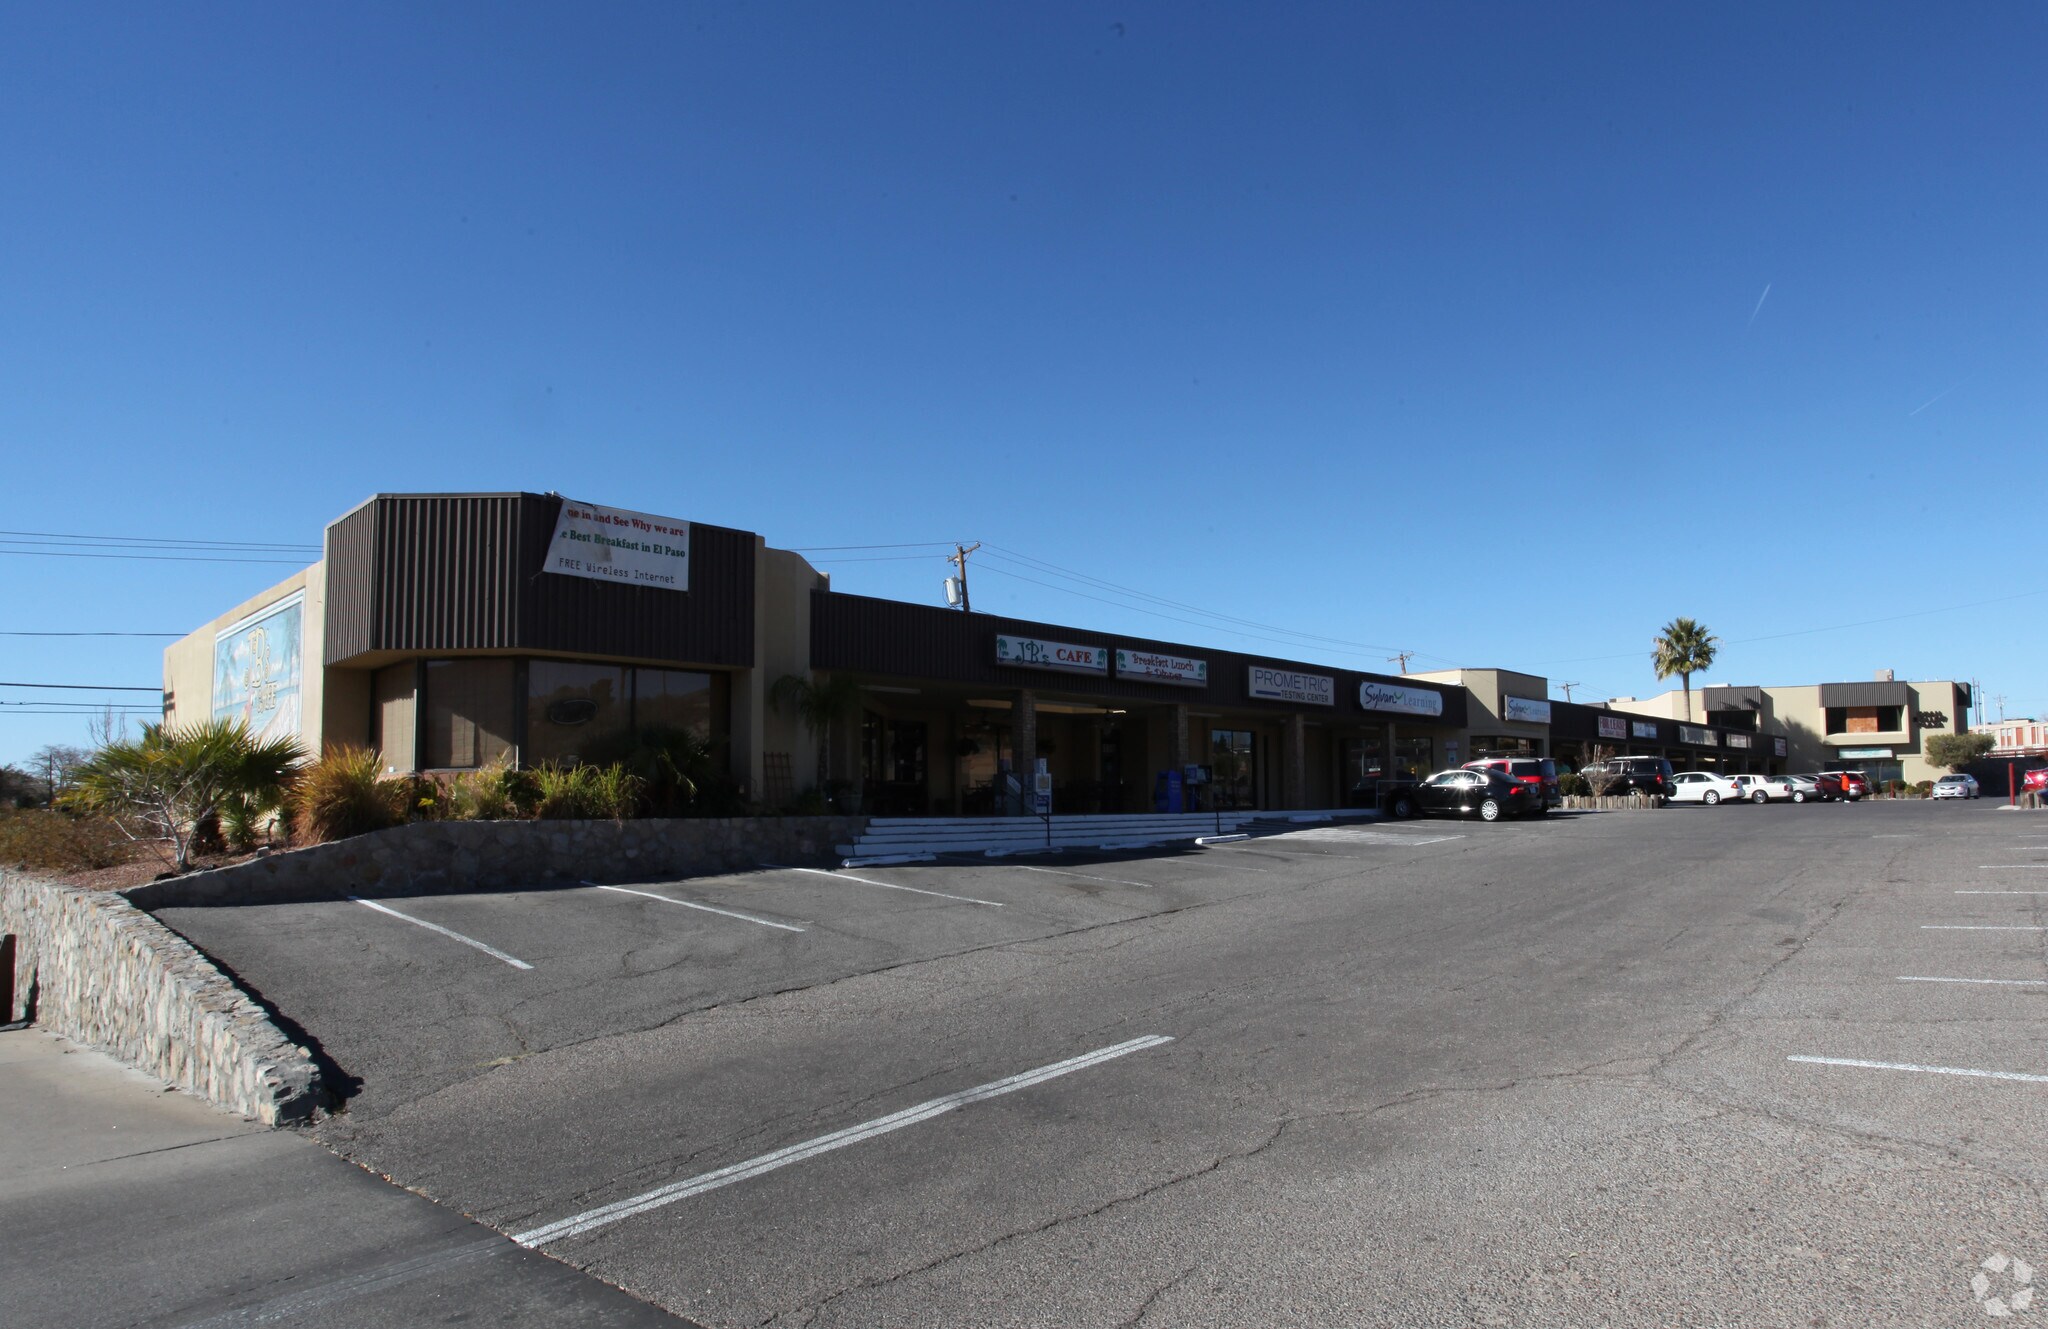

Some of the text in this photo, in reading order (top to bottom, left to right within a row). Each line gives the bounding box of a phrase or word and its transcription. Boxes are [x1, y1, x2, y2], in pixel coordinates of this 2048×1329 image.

[582, 510, 591, 520] in
[594, 514, 610, 524] and
[614, 516, 629, 526] See
[632, 518, 652, 532] Why
[654, 524, 667, 533] we
[670, 528, 684, 536] are
[570, 530, 591, 542] Best
[594, 534, 639, 550] Breakfast
[642, 542, 650, 552] in
[654, 544, 662, 554] El
[665, 546, 685, 558] Paso
[560, 558, 674, 584] FREE Wireless Internet
[1015, 640, 1092, 666] JB's CAFE
[1132, 653, 1194, 672] Breakfast Lunch
[1156, 668, 1182, 681] Dinner
[1255, 670, 1328, 693] PROMETRIC
[1281, 690, 1328, 702] TESTING CENTER
[1365, 684, 1436, 712] Sylvan Learning
